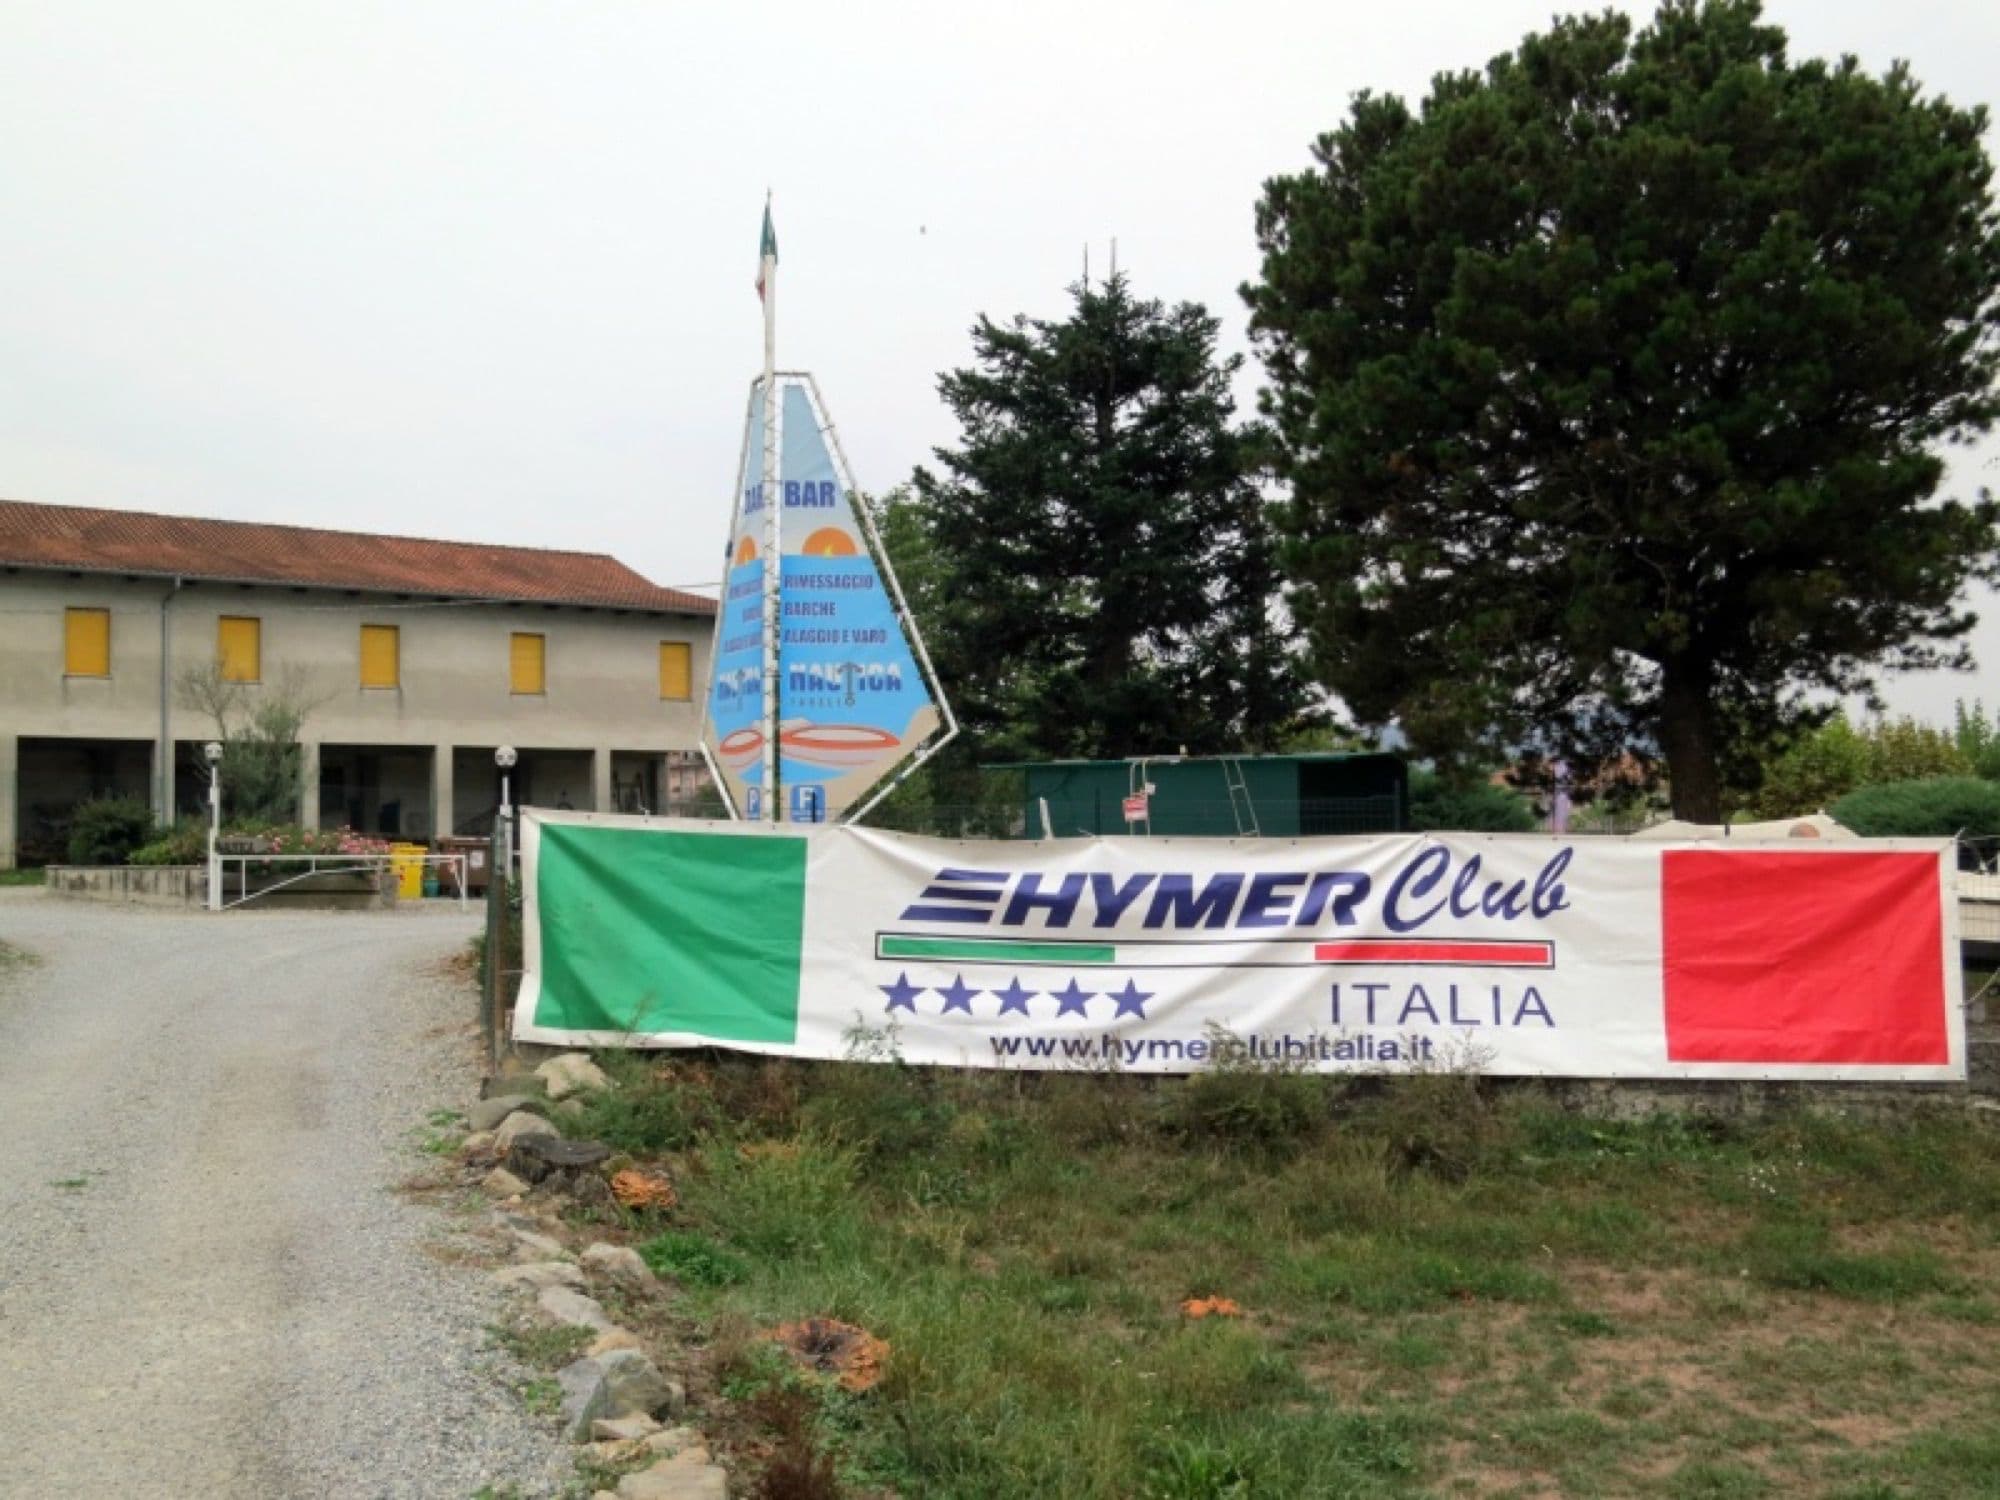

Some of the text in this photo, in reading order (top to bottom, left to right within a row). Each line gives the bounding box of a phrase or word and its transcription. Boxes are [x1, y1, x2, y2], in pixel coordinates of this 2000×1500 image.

[784, 481, 835, 507] BAR
[784, 574, 873, 588] RIMESSAGGIO
[784, 602, 836, 616] BARCHE
[783, 629, 886, 644] ALAGGIO E VARO
[1001, 846, 1573, 933] HYMER Club
[1331, 984, 1555, 1027] ITALIA
